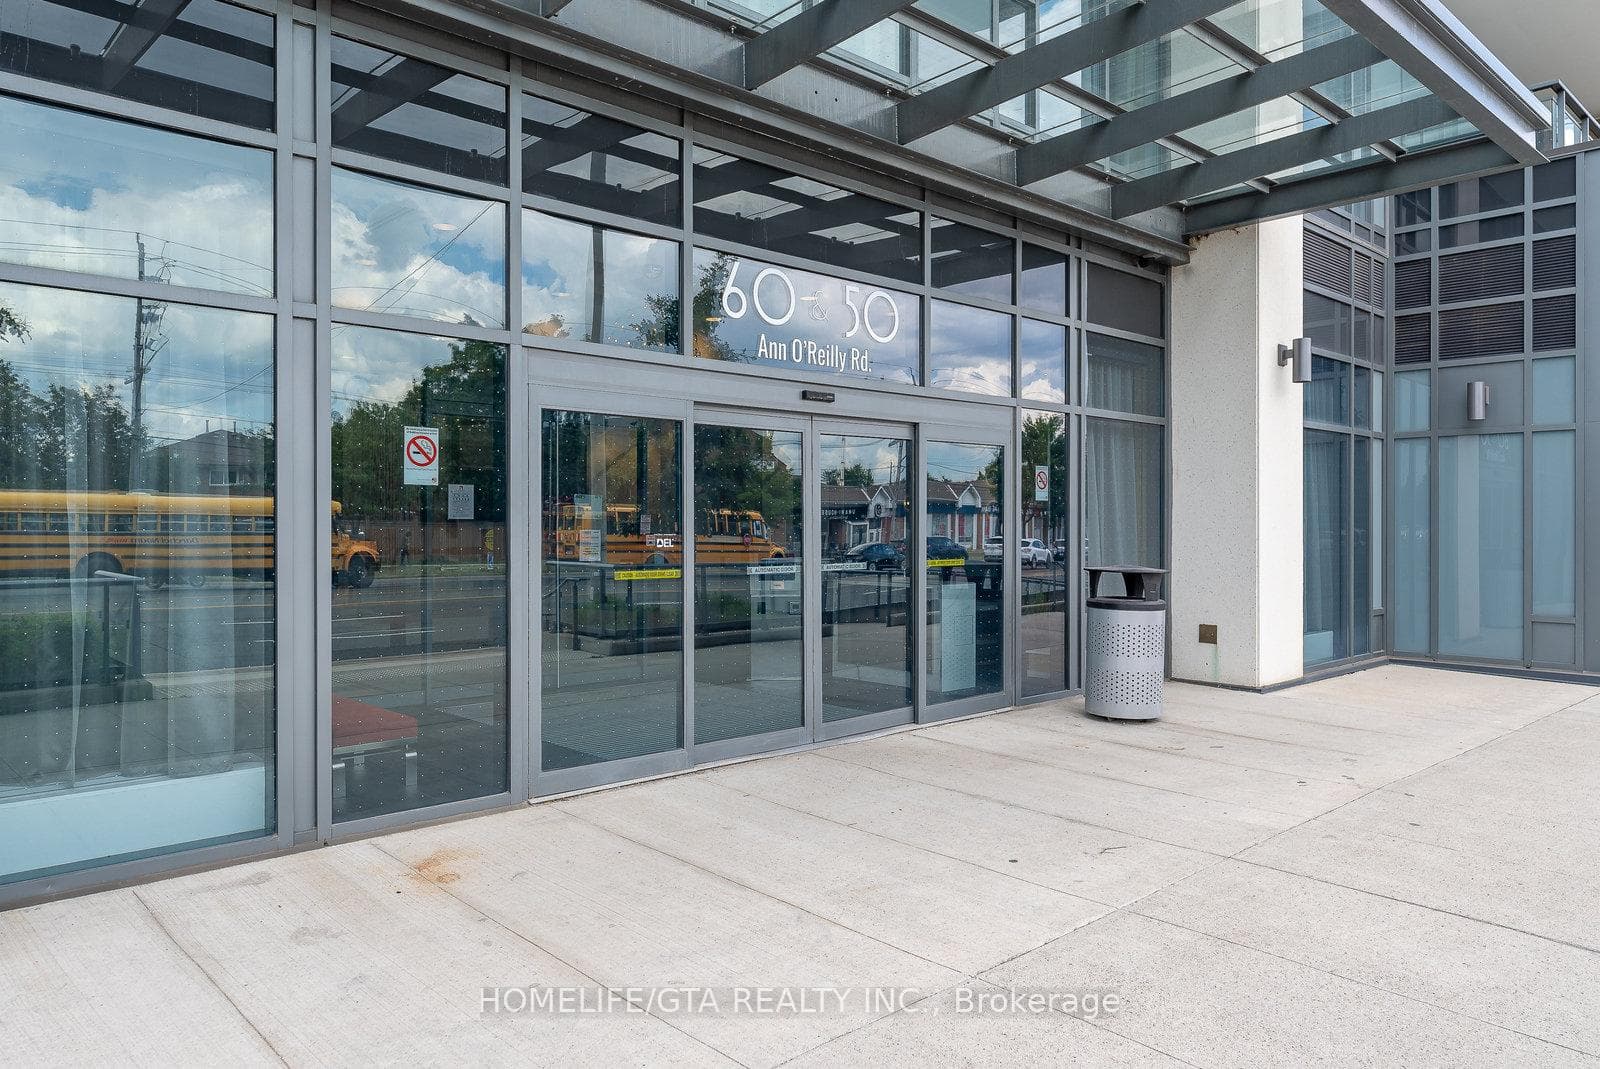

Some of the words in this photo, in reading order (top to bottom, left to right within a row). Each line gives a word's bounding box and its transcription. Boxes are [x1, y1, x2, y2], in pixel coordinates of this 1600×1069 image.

[722, 261, 796, 326] 60
[843, 283, 899, 343] 50
[758, 333, 787, 361] Ann
[792, 337, 846, 372] O'Reilly
[851, 347, 872, 372] Rd.
